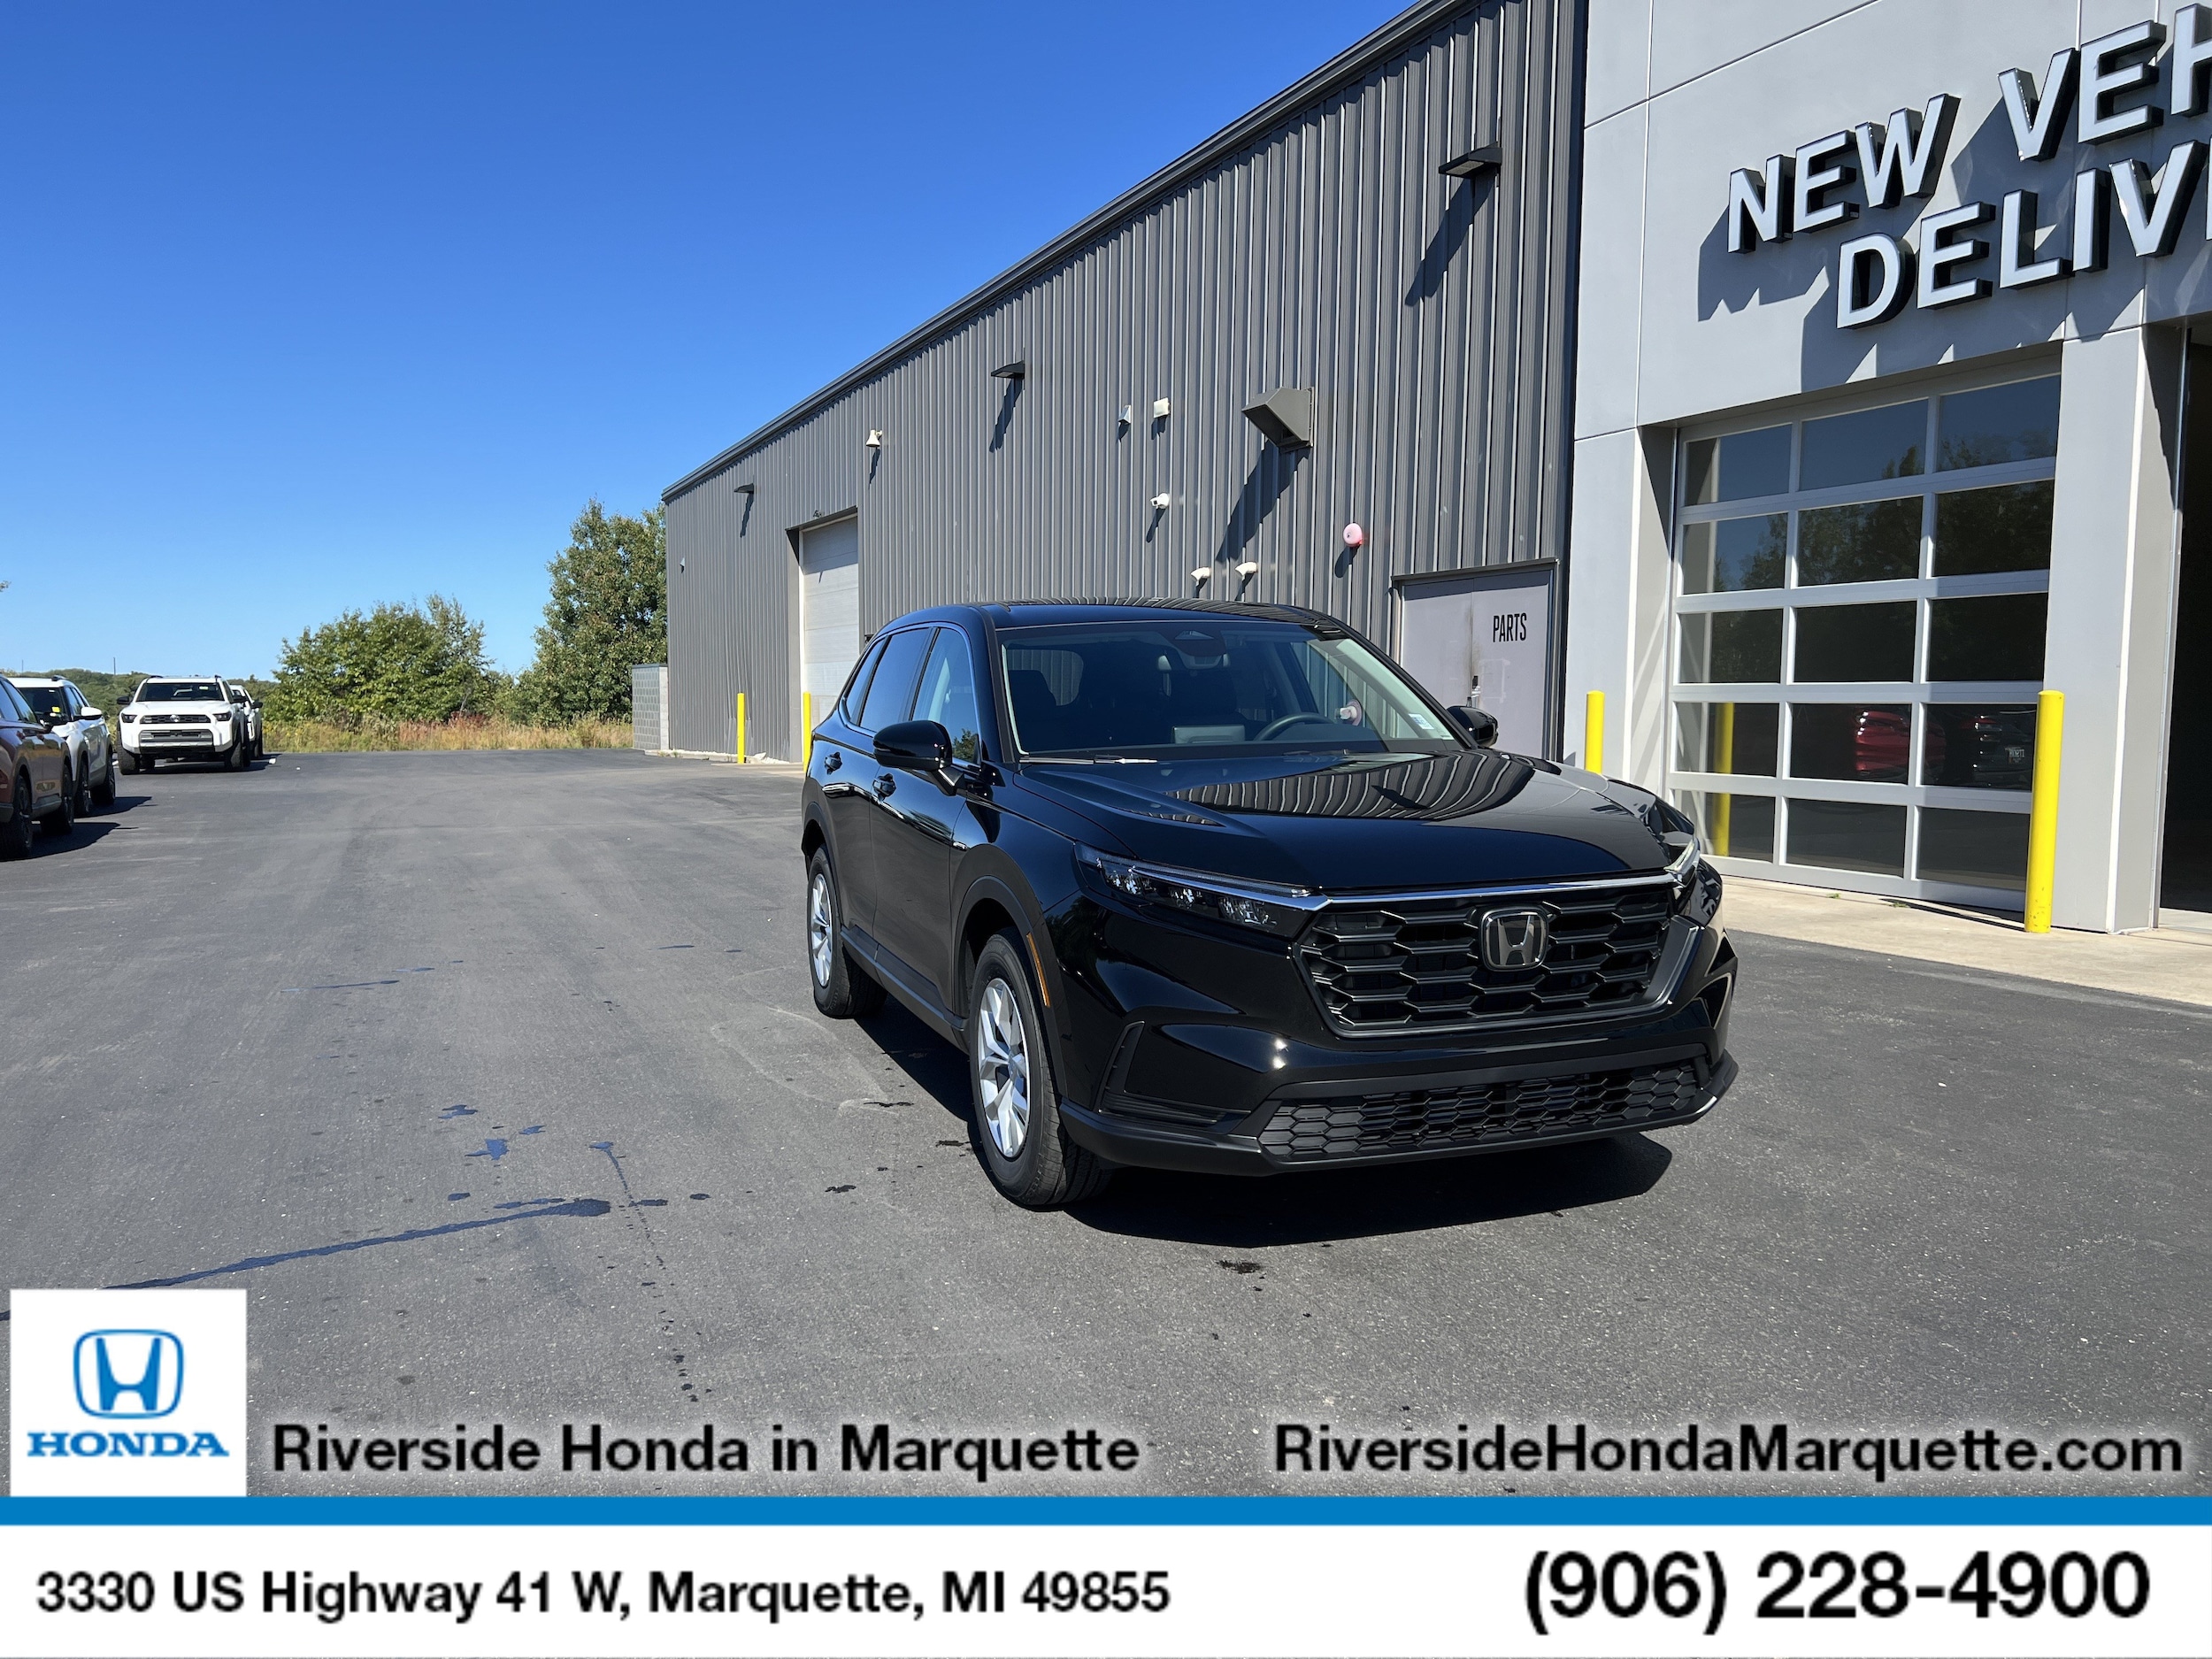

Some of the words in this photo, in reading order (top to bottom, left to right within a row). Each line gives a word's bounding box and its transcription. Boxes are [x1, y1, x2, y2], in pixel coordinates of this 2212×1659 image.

[1726, 93, 1961, 254] NEW
[1836, 135, 2212, 330] DELIV
[1493, 612, 1527, 642] PARTS
